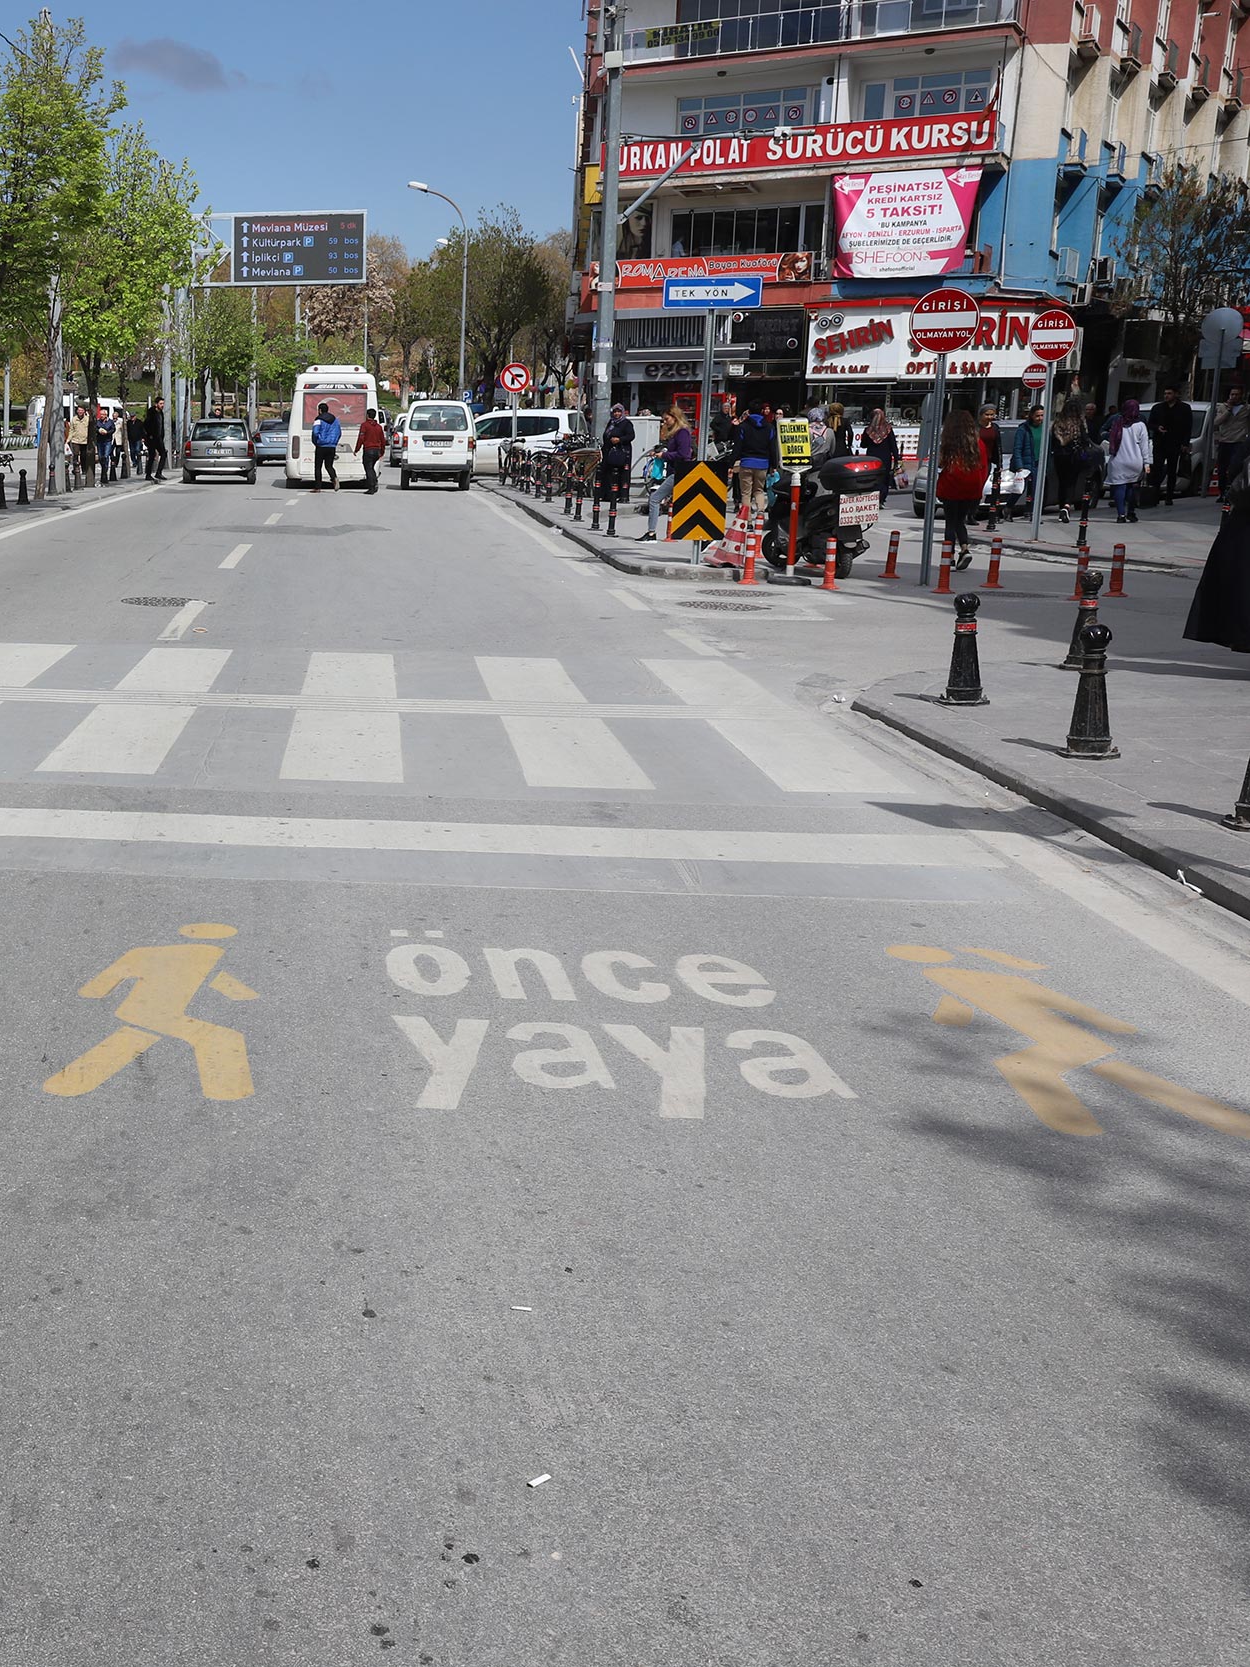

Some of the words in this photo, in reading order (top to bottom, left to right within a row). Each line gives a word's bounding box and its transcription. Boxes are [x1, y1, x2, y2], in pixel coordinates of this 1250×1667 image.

[690, 138, 751, 167] POLAT
[890, 119, 990, 152] KURSU
[868, 181, 944, 195] PEŞİNATSIZ
[867, 196, 897, 205] KREDİ
[900, 193, 943, 204] KARTSIZ
[866, 210, 875, 219] 5
[252, 224, 291, 233] Mevlana
[294, 222, 328, 232] Müzesi
[892, 219, 928, 228] KAMPANYA
[841, 232, 863, 240] AFYON
[868, 230, 893, 239] DENİZLİ
[899, 228, 930, 237] ERZURUM
[252, 237, 302, 249] Kültürpark
[902, 237, 910, 246] DE
[252, 251, 280, 263] İplikçi
[709, 260, 738, 271] Bayan
[740, 258, 779, 269] Kuaförü
[252, 267, 291, 276] Mevlana
[328, 266, 338, 274] 50
[674, 289, 696, 298] TEK
[704, 287, 729, 297] YÖN
[922, 298, 967, 311] GİRİŞİ
[1037, 318, 1069, 328] GİRİŞİ
[814, 318, 894, 363] ŞEHRİN
[916, 331, 953, 339] OLMAYAN
[956, 330, 971, 338] YOL
[906, 358, 938, 375] OPTİ
[948, 361, 958, 374] &
[960, 361, 993, 375] SAAT
[841, 506, 854, 514] ALO
[856, 504, 879, 513] PAKET:
[840, 516, 854, 525] 0332
[386, 929, 777, 1008] önce
[391, 1014, 860, 1119] yaya
